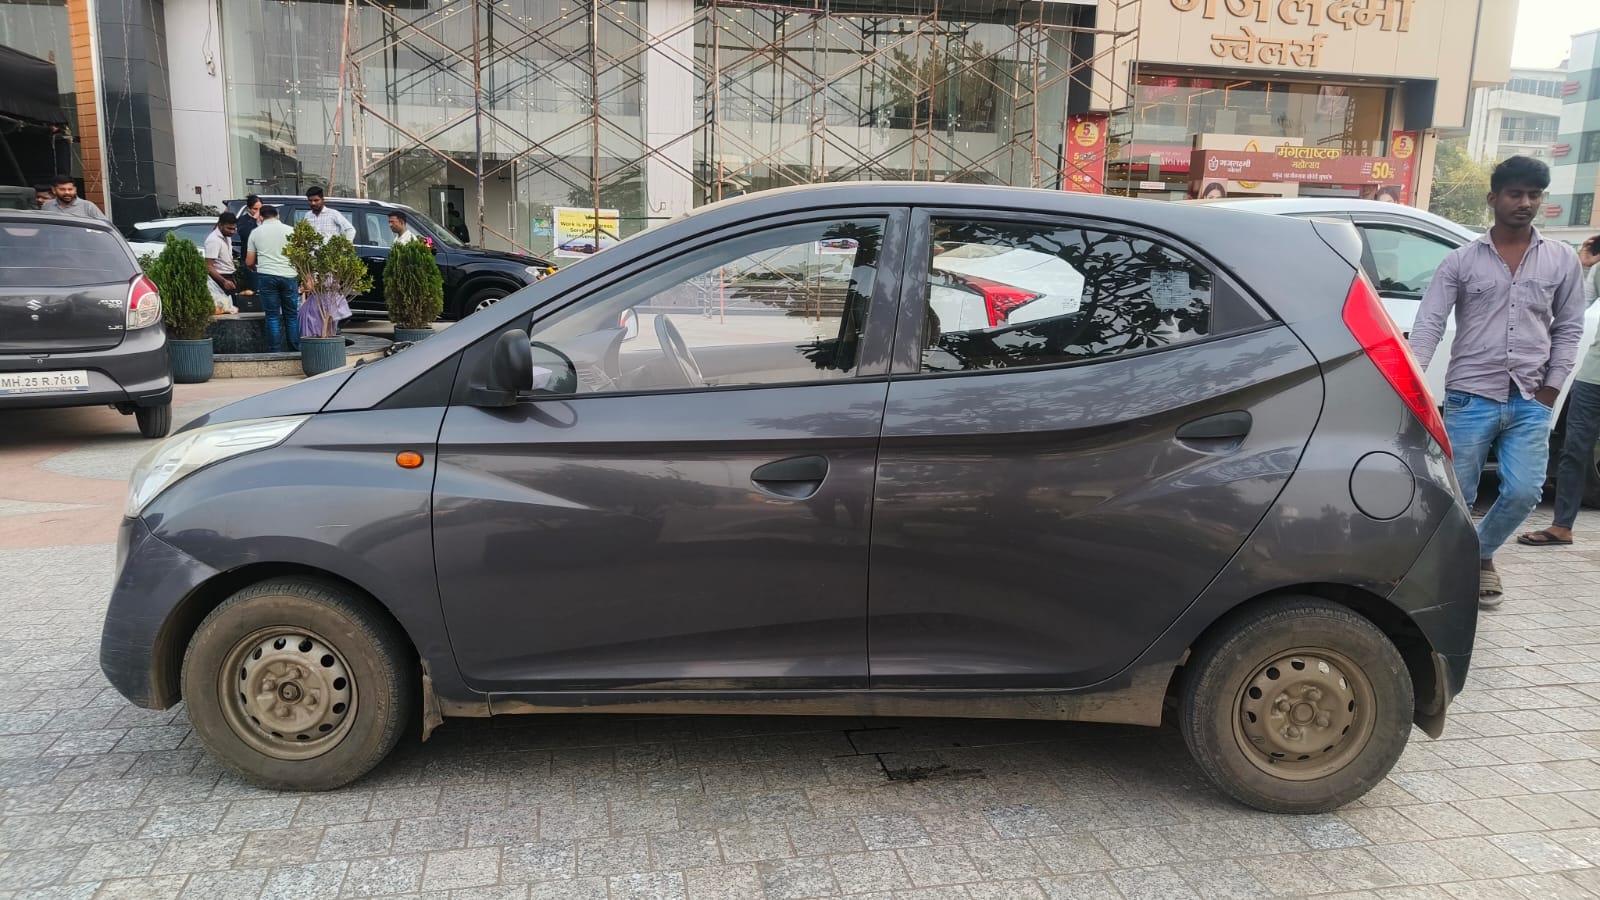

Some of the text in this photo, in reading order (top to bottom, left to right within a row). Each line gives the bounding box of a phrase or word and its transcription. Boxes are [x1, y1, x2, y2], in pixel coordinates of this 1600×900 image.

[1210, 26, 1329, 68] ज्वेलर्स
[1083, 123, 1091, 136] 5
[1277, 142, 1341, 159] मंगलाष्टक
[1400, 137, 1407, 149] 5
